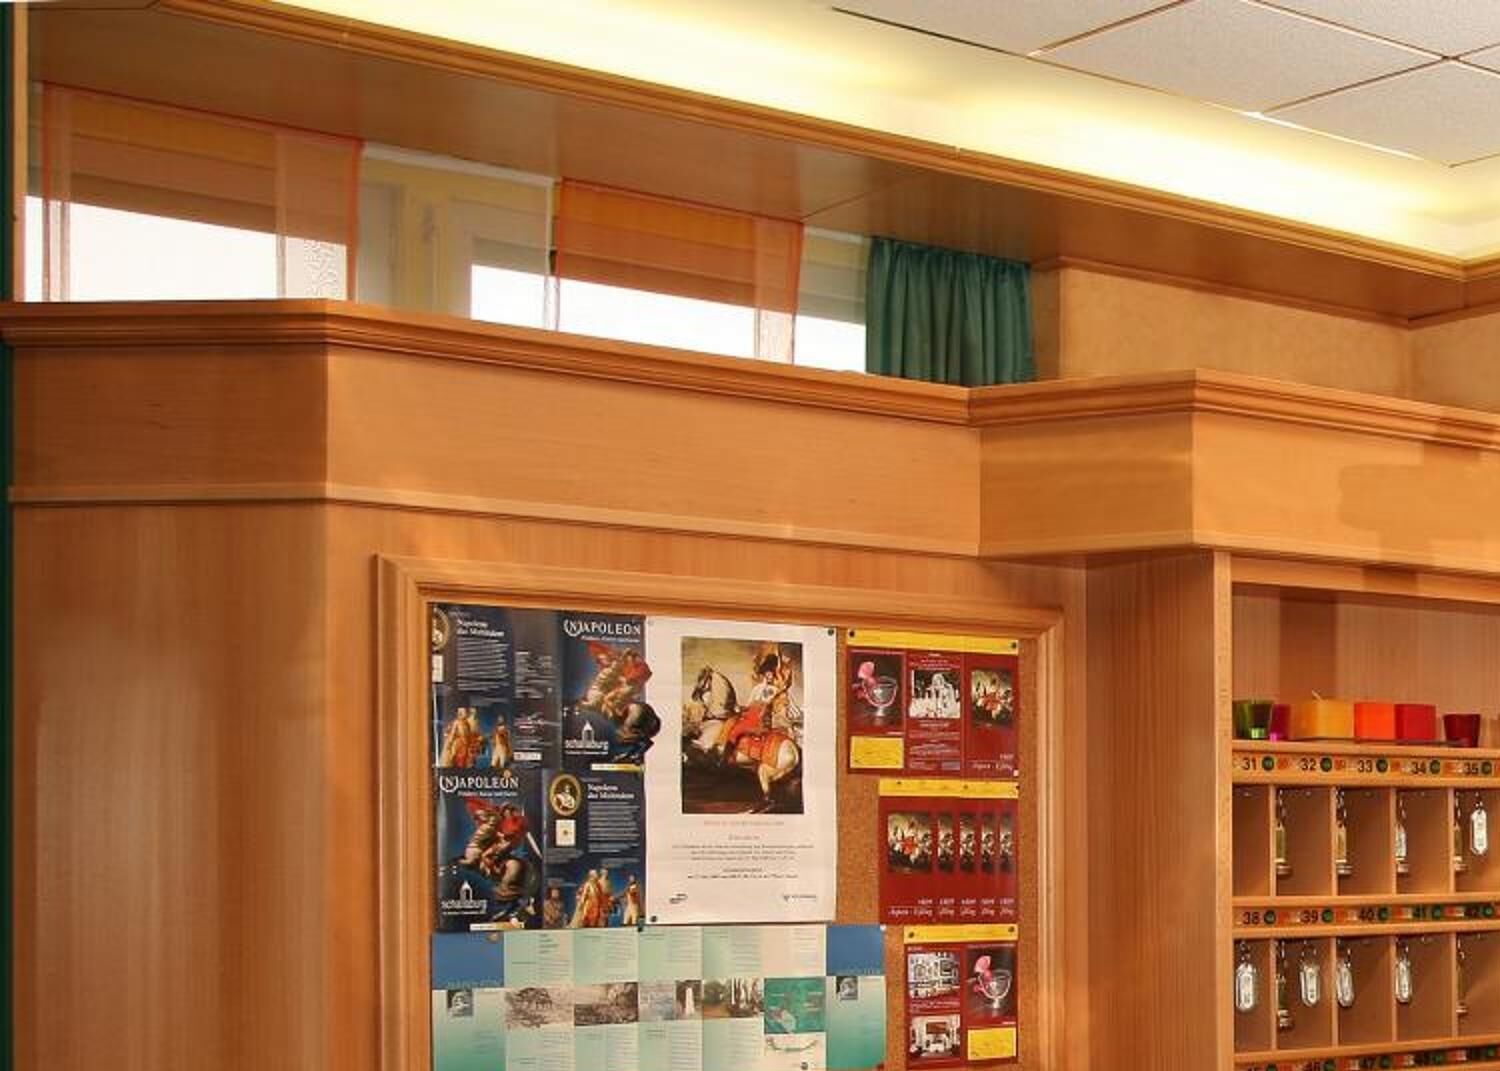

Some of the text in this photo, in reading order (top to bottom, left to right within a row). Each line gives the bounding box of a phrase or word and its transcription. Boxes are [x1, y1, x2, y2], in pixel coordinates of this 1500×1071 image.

[563, 619, 641, 637] NAPOLEON
[1242, 757, 1257, 771] 31
[1301, 757, 1317, 771] 32
[1357, 759, 1373, 772] 33
[1411, 761, 1427, 775] 34
[1464, 762, 1479, 775] 35
[439, 775, 519, 793] NAPOLEON
[1242, 911, 1260, 925] 38
[1301, 910, 1319, 923] 39
[1359, 908, 1375, 921] 40
